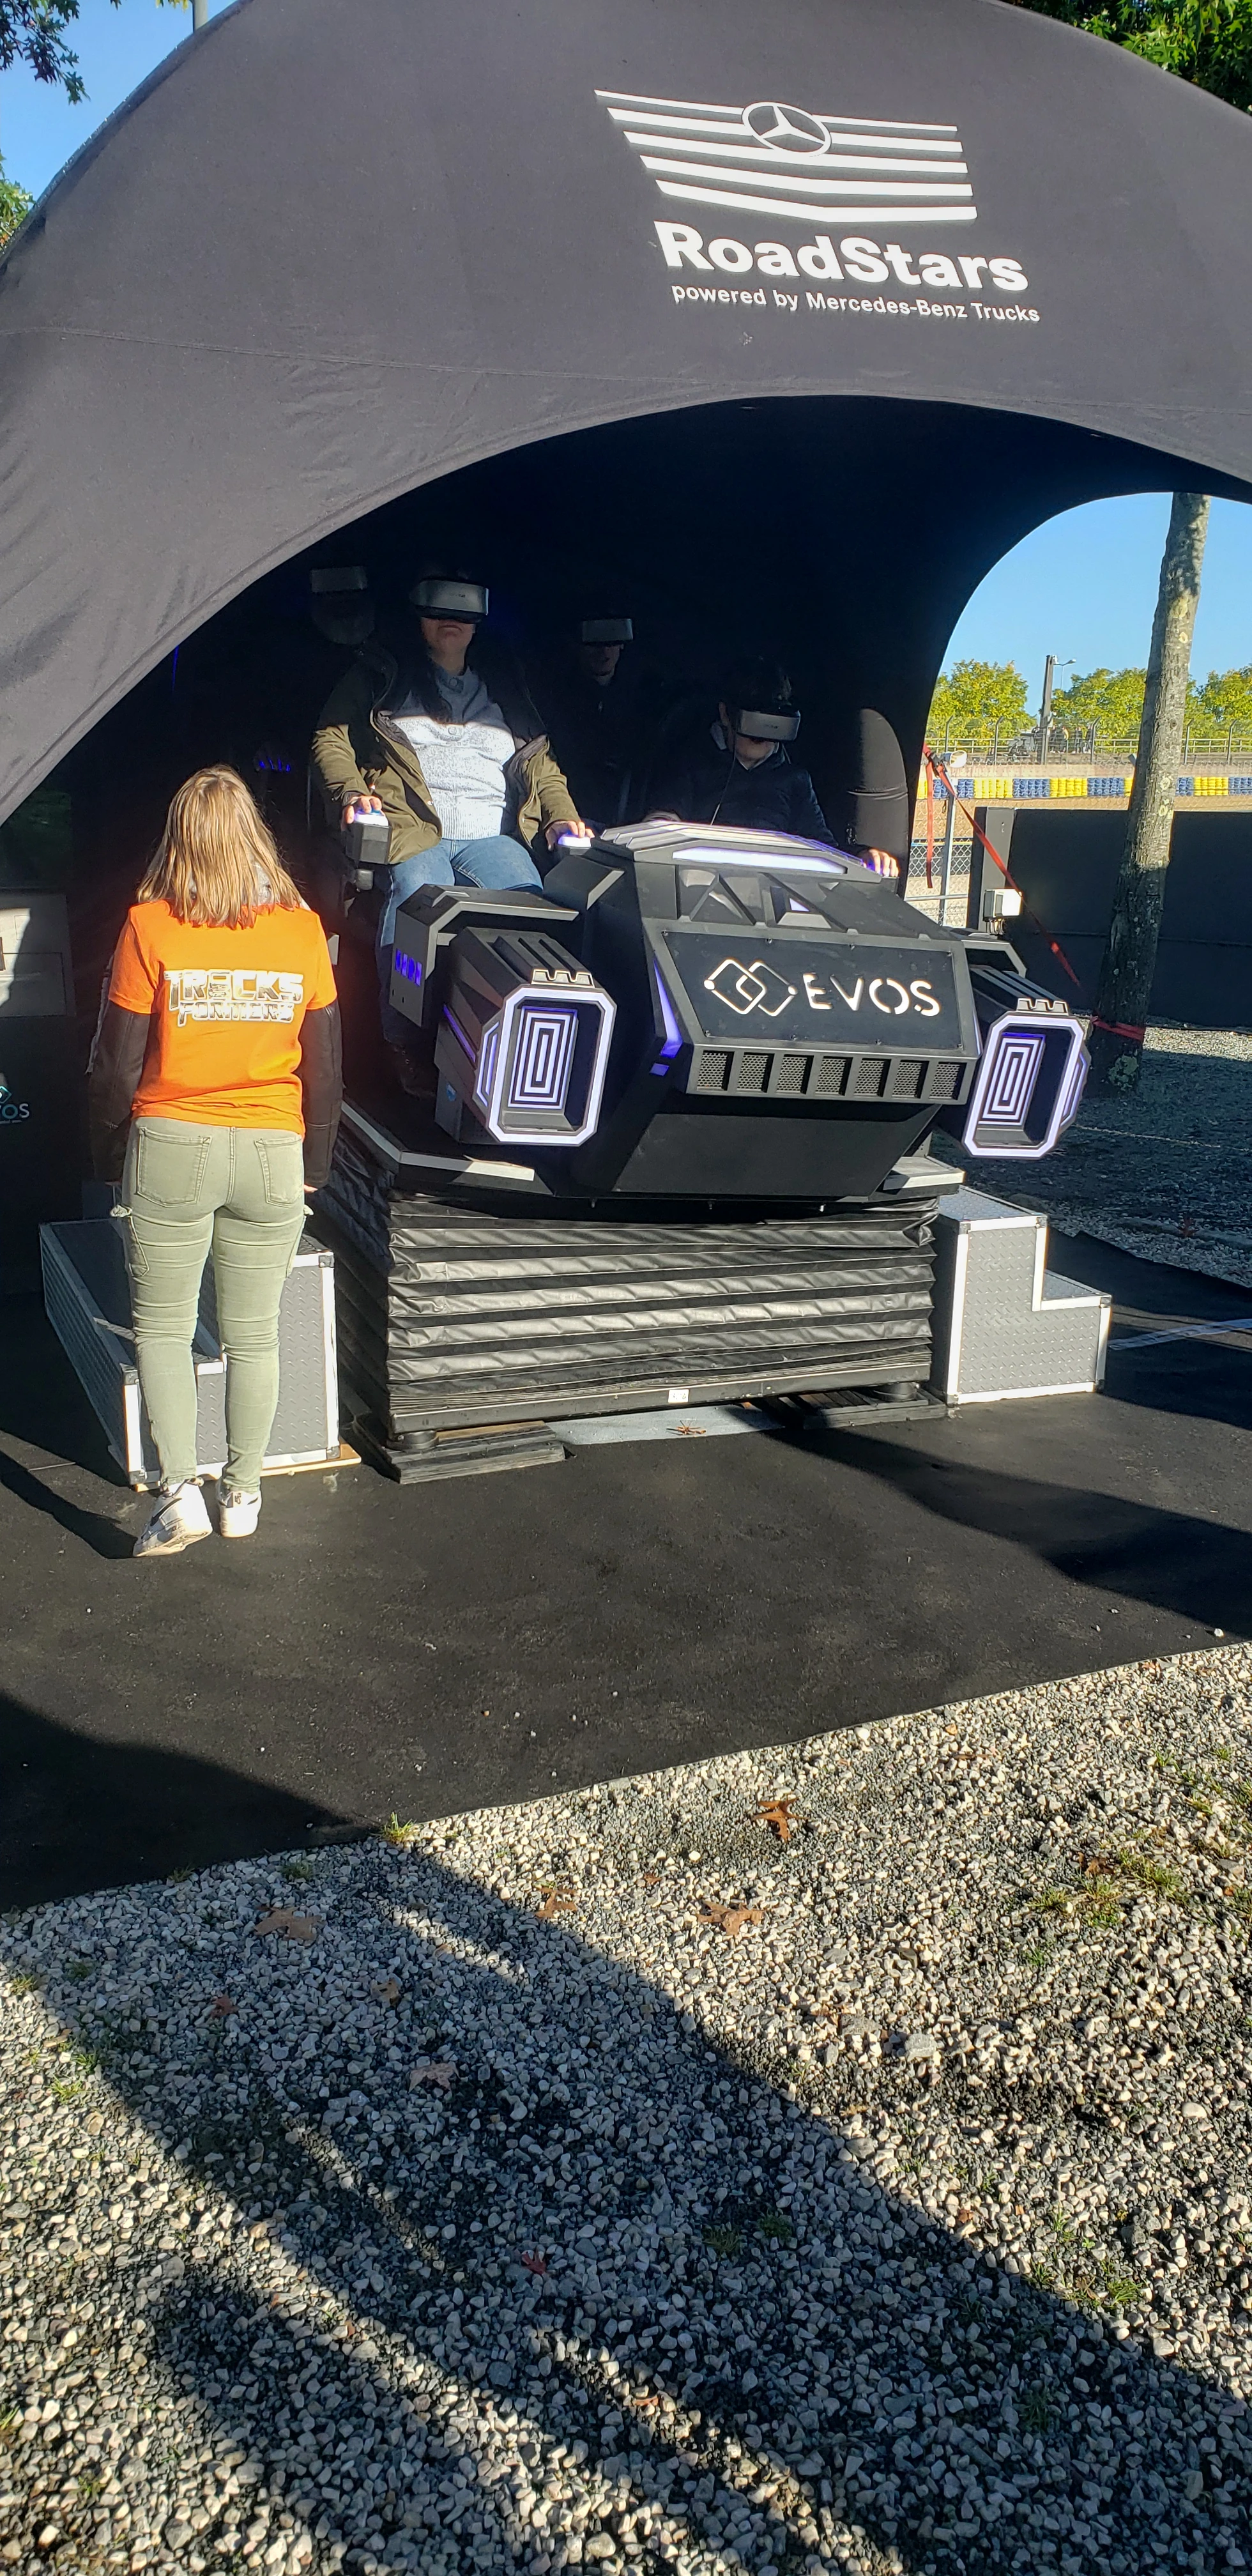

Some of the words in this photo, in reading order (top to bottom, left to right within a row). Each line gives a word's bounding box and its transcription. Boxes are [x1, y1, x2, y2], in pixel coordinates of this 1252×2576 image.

[653, 220, 1028, 291] RoadStars
[671, 285, 767, 303] powered
[772, 289, 798, 311] by
[805, 292, 968, 318] Mercedes-Benz
[970, 302, 1040, 321] Trucks
[802, 972, 941, 1016] EVOS
[0, 1103, 30, 1119] OS
